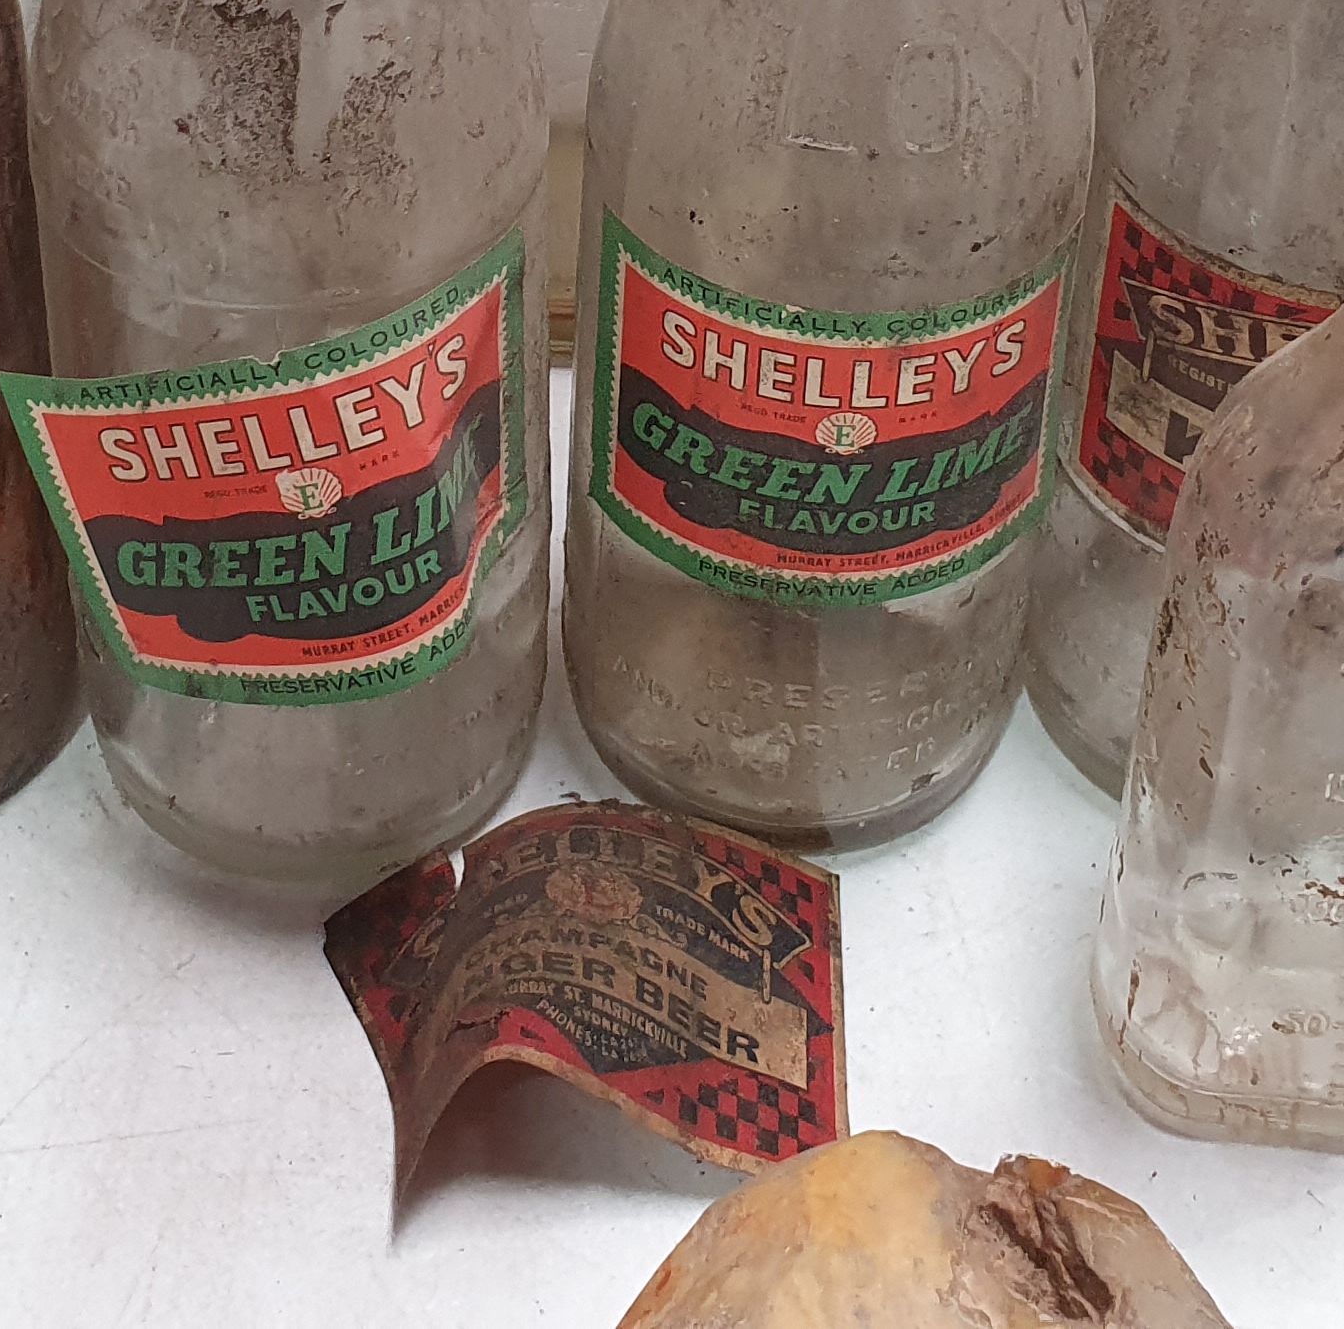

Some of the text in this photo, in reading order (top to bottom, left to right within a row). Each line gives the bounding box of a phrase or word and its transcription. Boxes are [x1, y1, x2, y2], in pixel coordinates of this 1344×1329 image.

[662, 265, 1036, 336] ARTIFICIALLY COLOURED
[78, 287, 462, 405] ARTIFICIALLY COLOURED
[660, 308, 1027, 410] SHELLEY'S
[98, 334, 468, 484] SHELLEY'S
[630, 400, 1034, 506] GREEN LIME
[738, 497, 937, 536] FLAVOUR
[116, 520, 355, 590] GREEN
[246, 549, 444, 624] FLAVOUR
[697, 557, 966, 598] PRESERVATIVE ADDED
[241, 657, 418, 696] PRESERVATIVE
[301, 641, 356, 657] MURRAY
[654, 903, 752, 963] TRADE MARK
[635, 974, 762, 1064] BEER
